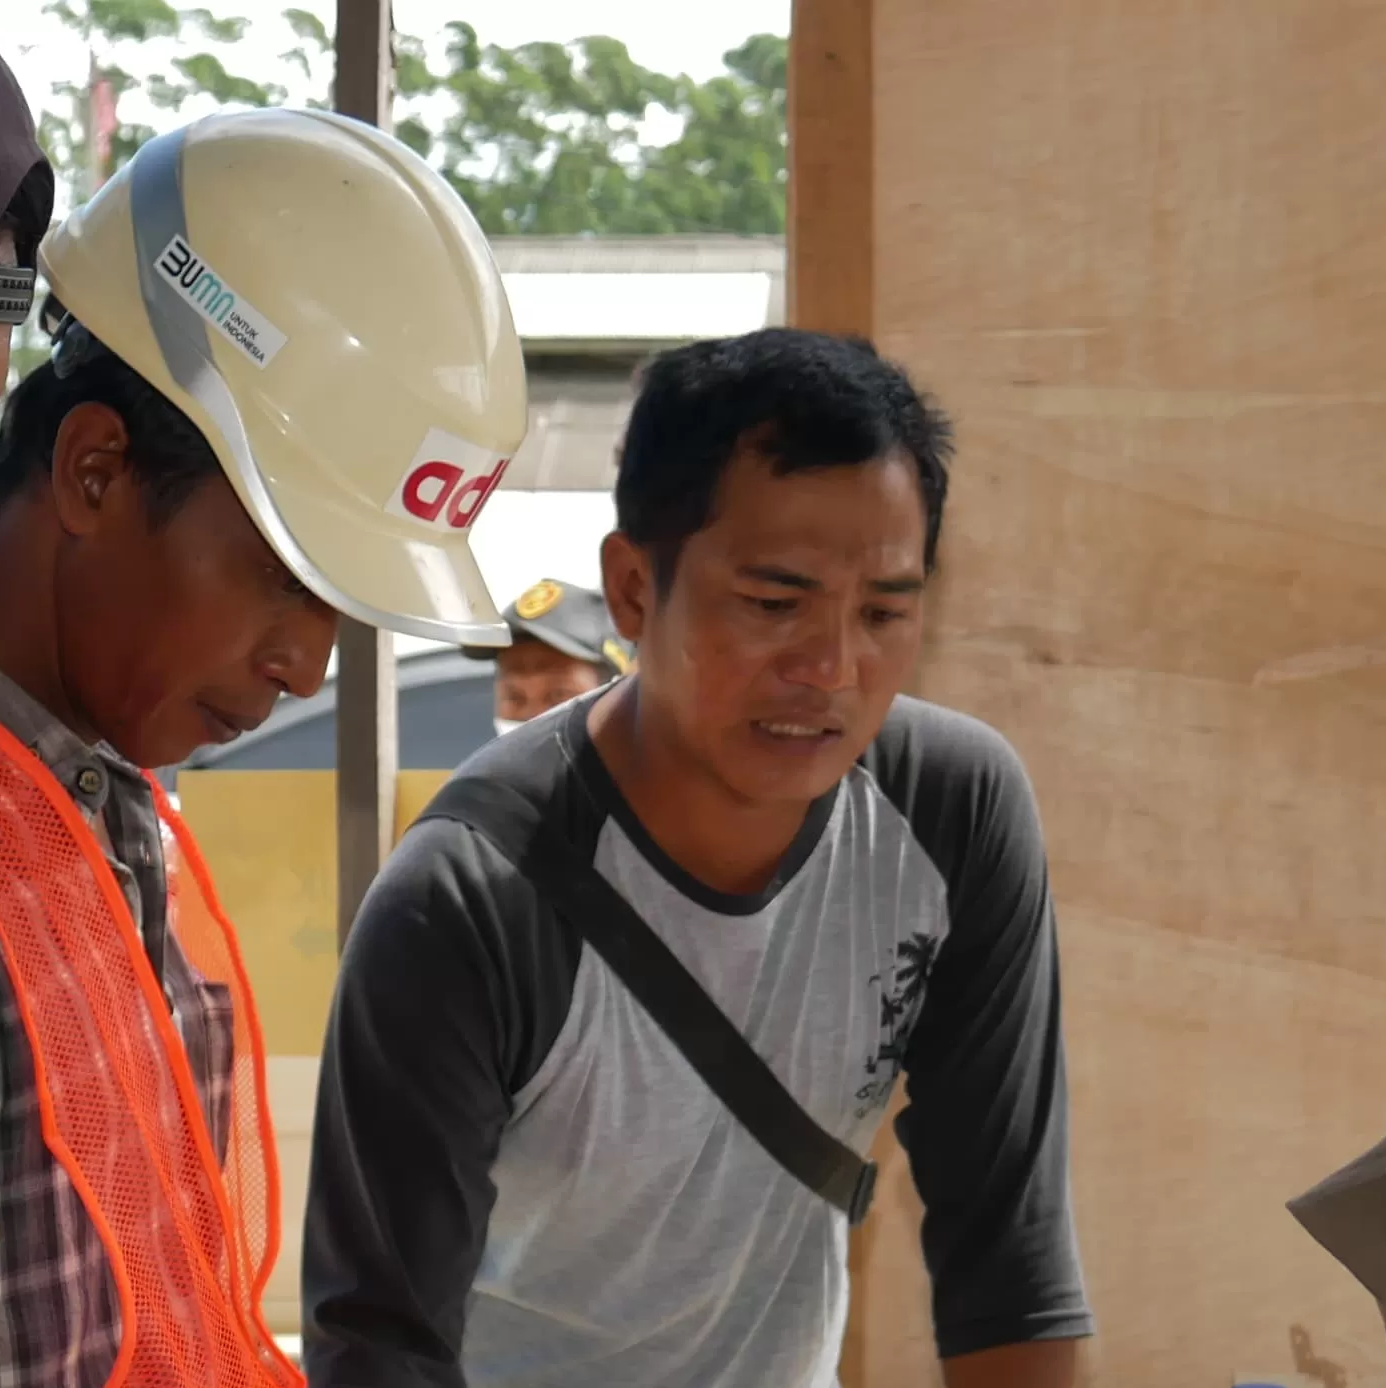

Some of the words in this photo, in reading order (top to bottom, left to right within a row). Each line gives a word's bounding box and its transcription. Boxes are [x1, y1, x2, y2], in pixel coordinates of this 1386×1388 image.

[160, 240, 235, 323] BUMN
[222, 319, 265, 363] INDONESIA
[229, 311, 259, 341] UNTUK
